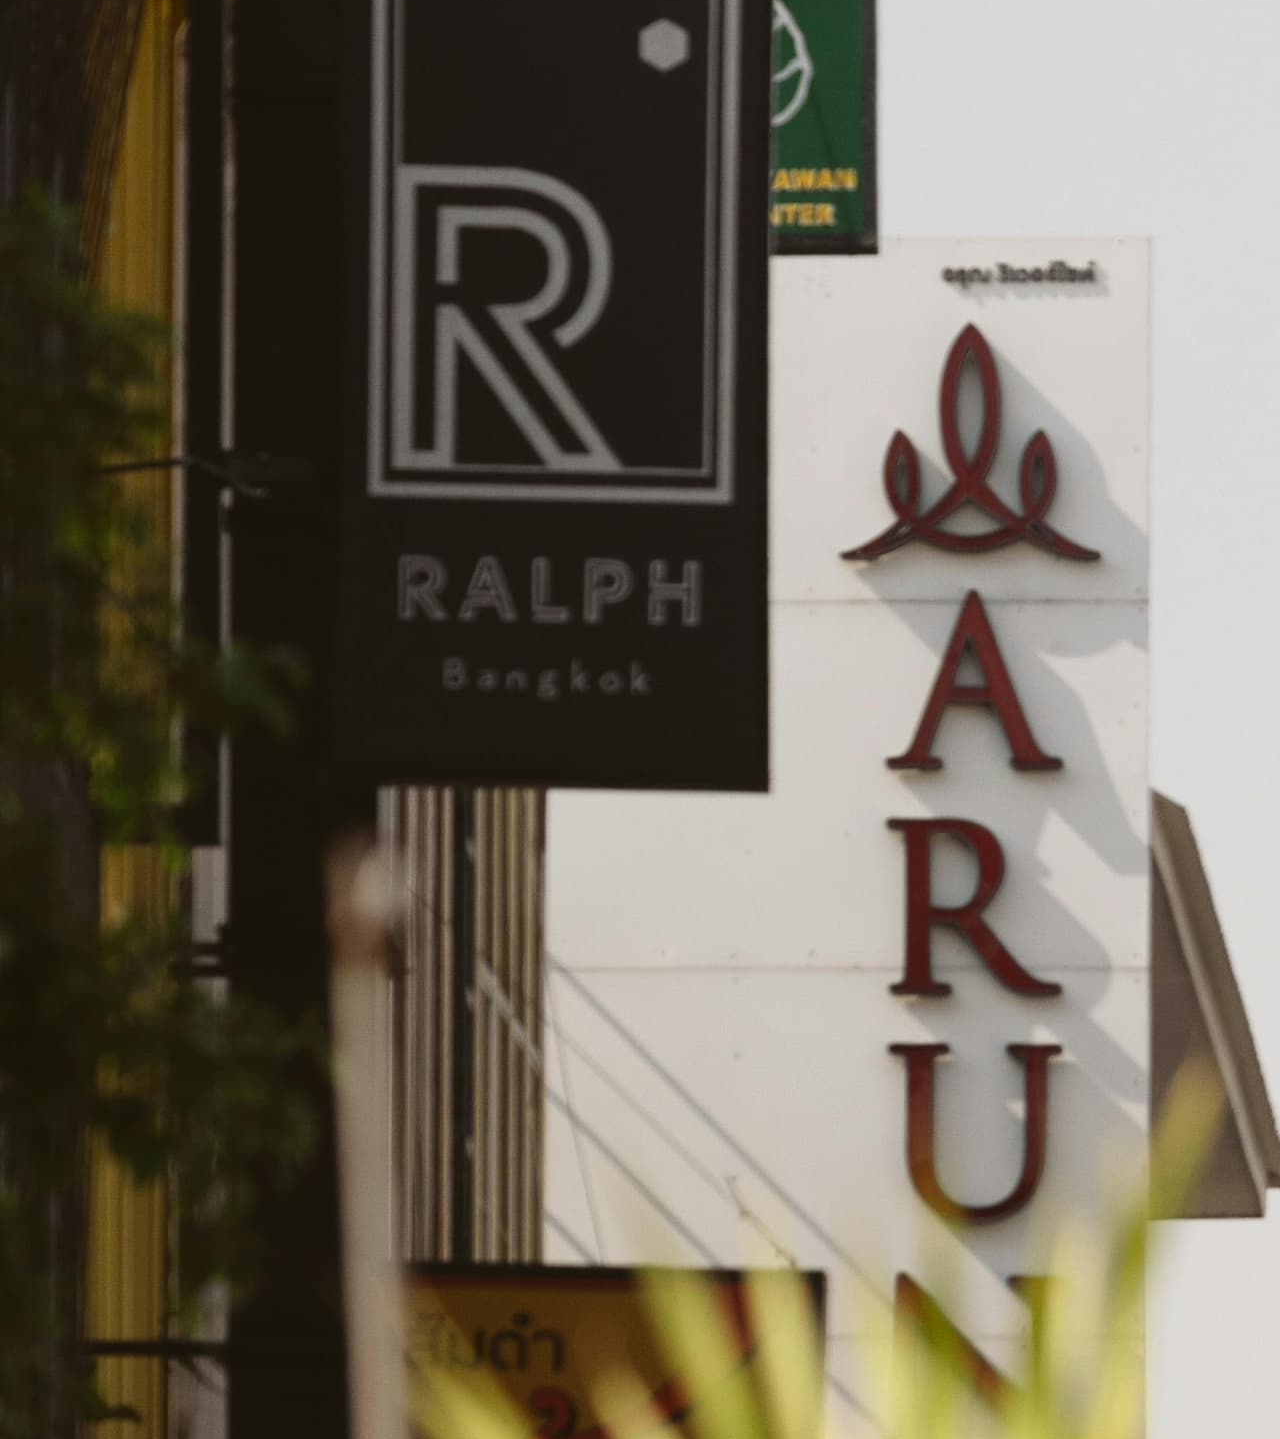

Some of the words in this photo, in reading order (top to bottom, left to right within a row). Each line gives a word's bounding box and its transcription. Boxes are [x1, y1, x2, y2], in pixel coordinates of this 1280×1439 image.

[768, 167, 858, 191] AWAN
[397, 553, 702, 627] RALPH
[442, 656, 651, 702] Bangkok
